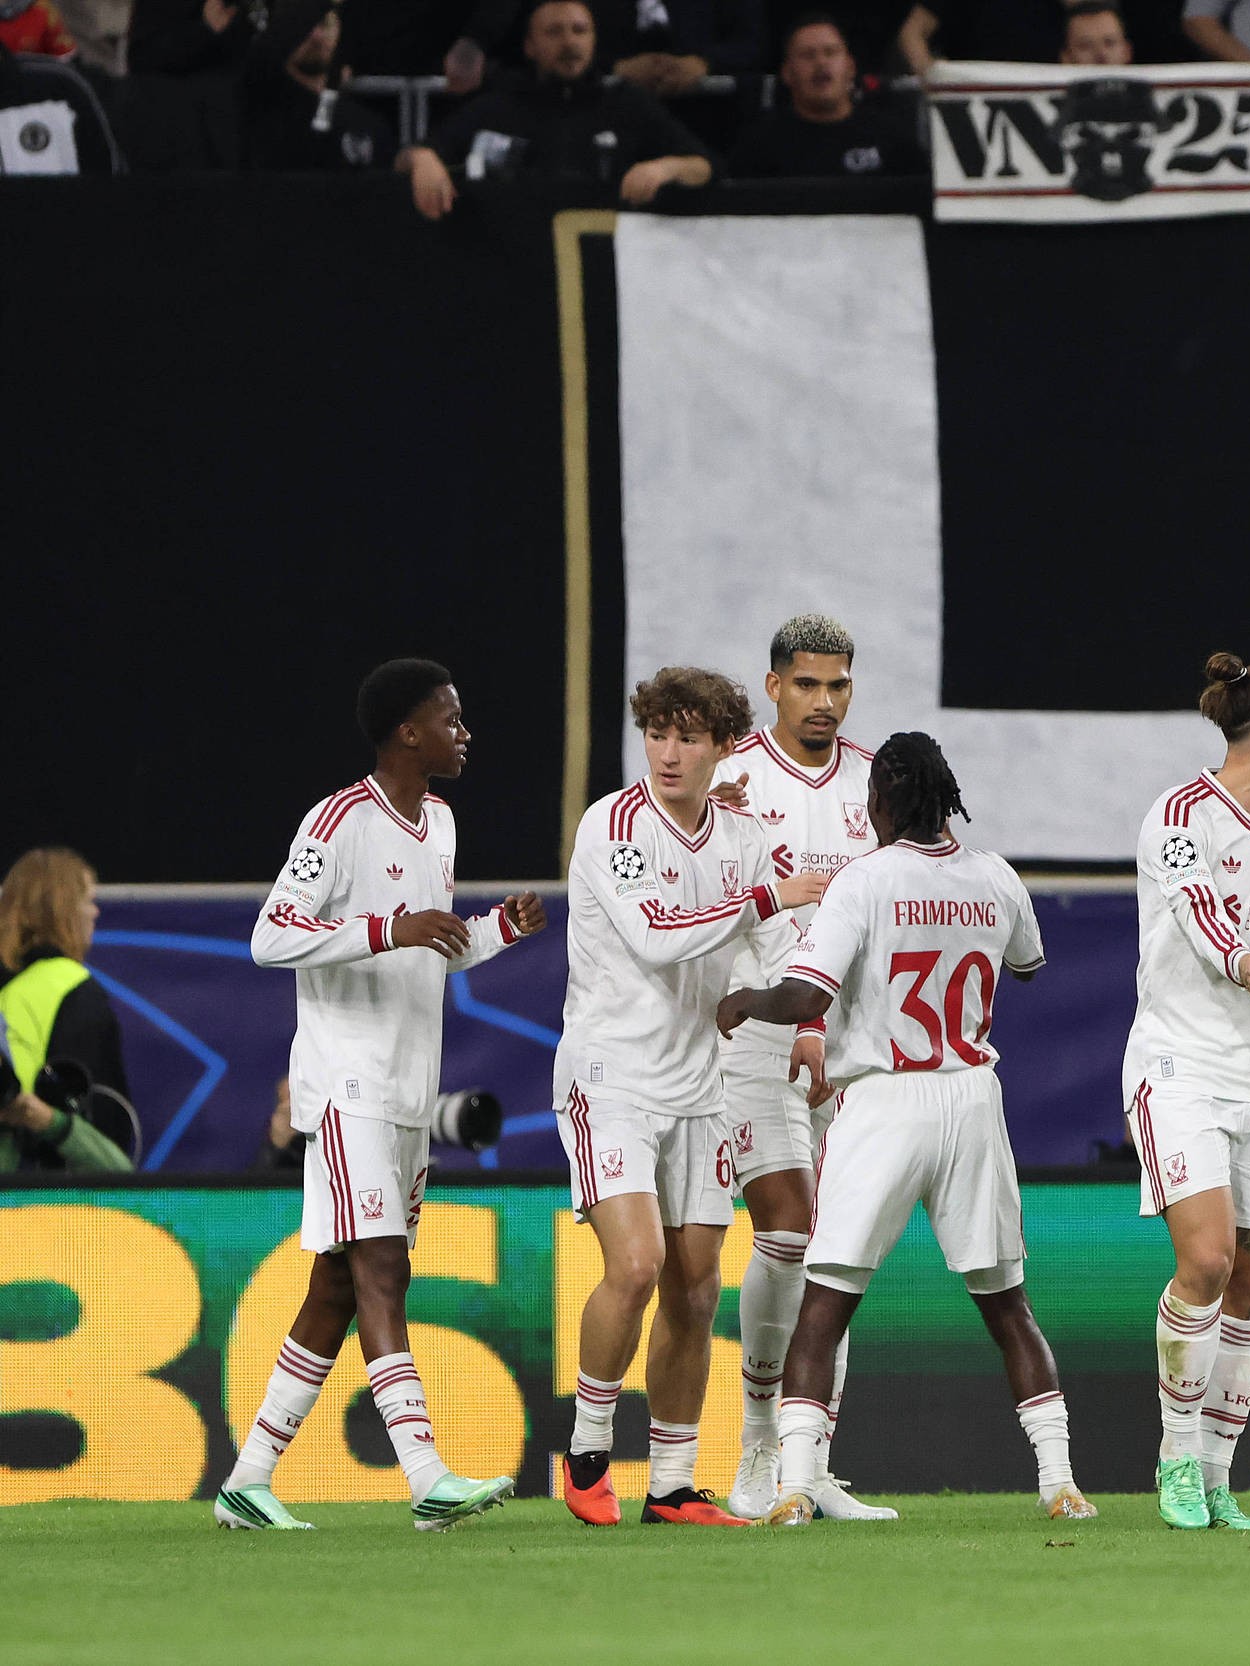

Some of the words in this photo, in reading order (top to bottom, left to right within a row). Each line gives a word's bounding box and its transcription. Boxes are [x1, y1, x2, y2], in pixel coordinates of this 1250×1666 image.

[894, 900, 996, 928] FRIMPONG
[888, 950, 996, 1072] 30
[716, 1139, 730, 1188] 6
[748, 1356, 780, 1370] LFC
[1168, 1374, 1206, 1389] LFC
